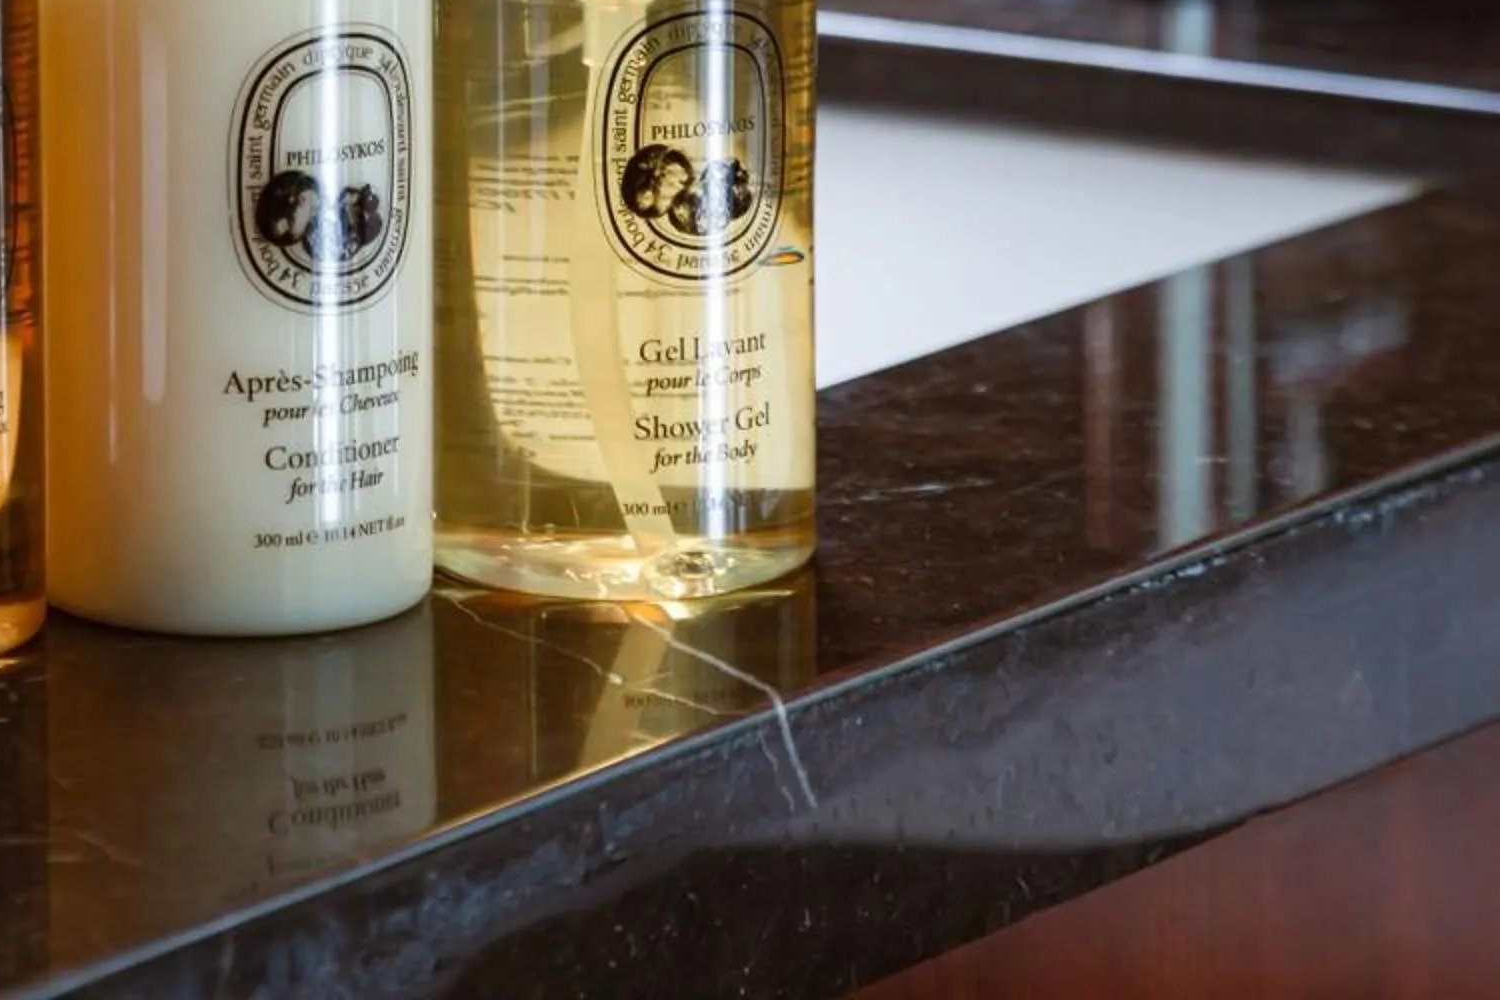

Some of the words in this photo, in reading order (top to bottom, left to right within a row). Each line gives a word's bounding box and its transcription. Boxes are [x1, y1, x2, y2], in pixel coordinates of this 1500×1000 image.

[617, 36, 661, 104] germain
[247, 136, 262, 179] saint
[255, 63, 296, 130] germain
[612, 110, 628, 151] saint
[651, 117, 755, 140] PHILOKOS
[286, 139, 385, 166] PHILSYKOS
[639, 337, 685, 362] Gel
[693, 333, 766, 360] Lvant
[223, 349, 419, 402] Après-Sampoing
[646, 375, 693, 396] pour
[715, 364, 762, 389] Corps
[263, 405, 310, 428] pour
[735, 401, 770, 431] Gel
[650, 448, 680, 474] for
[685, 445, 711, 465] the
[717, 439, 758, 463] Body
[285, 477, 314, 504] for
[350, 469, 384, 490] Hair
[254, 533, 282, 549] 300
[285, 532, 303, 547] ml
[358, 519, 385, 537] NET
